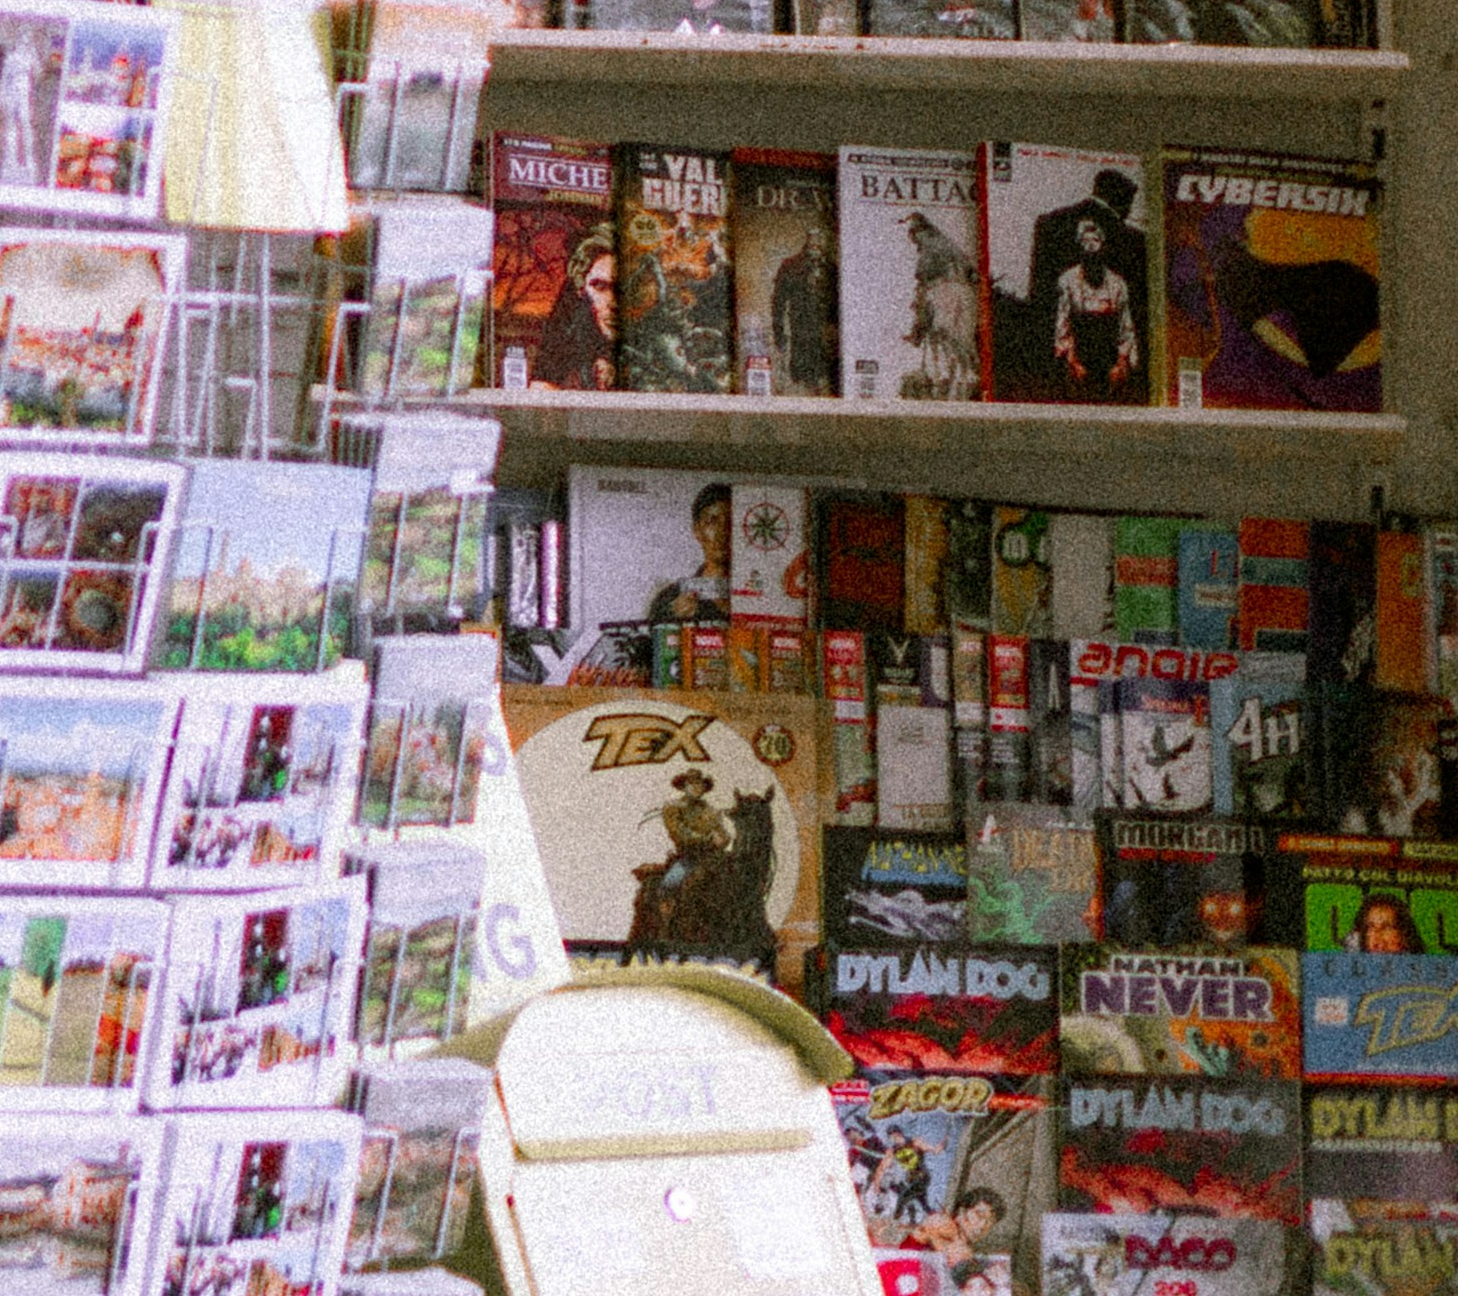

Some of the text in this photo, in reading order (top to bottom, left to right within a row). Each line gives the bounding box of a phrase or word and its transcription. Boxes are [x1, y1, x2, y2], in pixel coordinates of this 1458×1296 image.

[1176, 172, 1371, 217] CYBERSIX
[583, 712, 718, 772] TEX
[835, 950, 1053, 1001] DYLAN DOG
[1110, 953, 1248, 977] NATHAN
[1082, 973, 1274, 1023] NEVER
[869, 1077, 995, 1119] ZAGOR
[1069, 1085, 1288, 1133] DYLAN DOG
[1312, 1095, 1429, 1140] DYLAN
